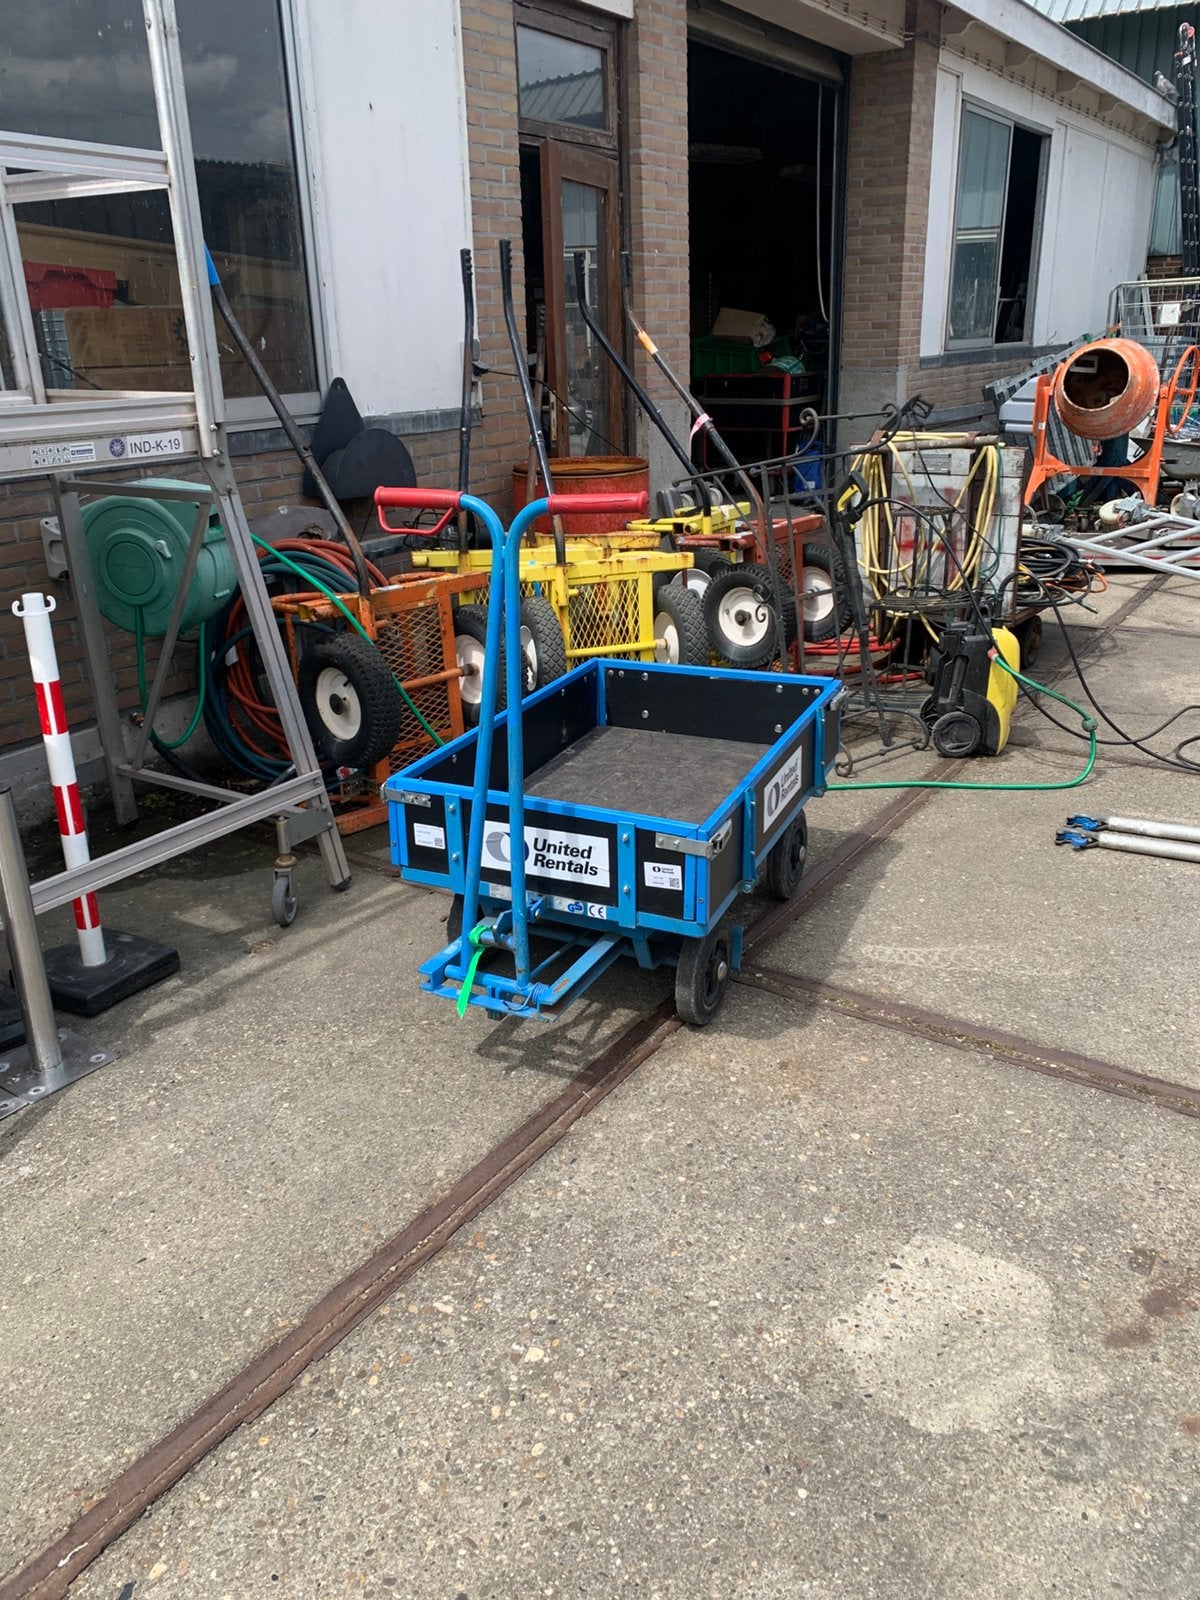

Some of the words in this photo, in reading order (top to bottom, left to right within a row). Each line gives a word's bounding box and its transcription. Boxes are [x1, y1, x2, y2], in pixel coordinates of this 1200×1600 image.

[130, 438, 180, 454] IND-K-19
[533, 837, 592, 860] United
[533, 853, 599, 876] Rentals
[588, 904, 604, 918] CE
